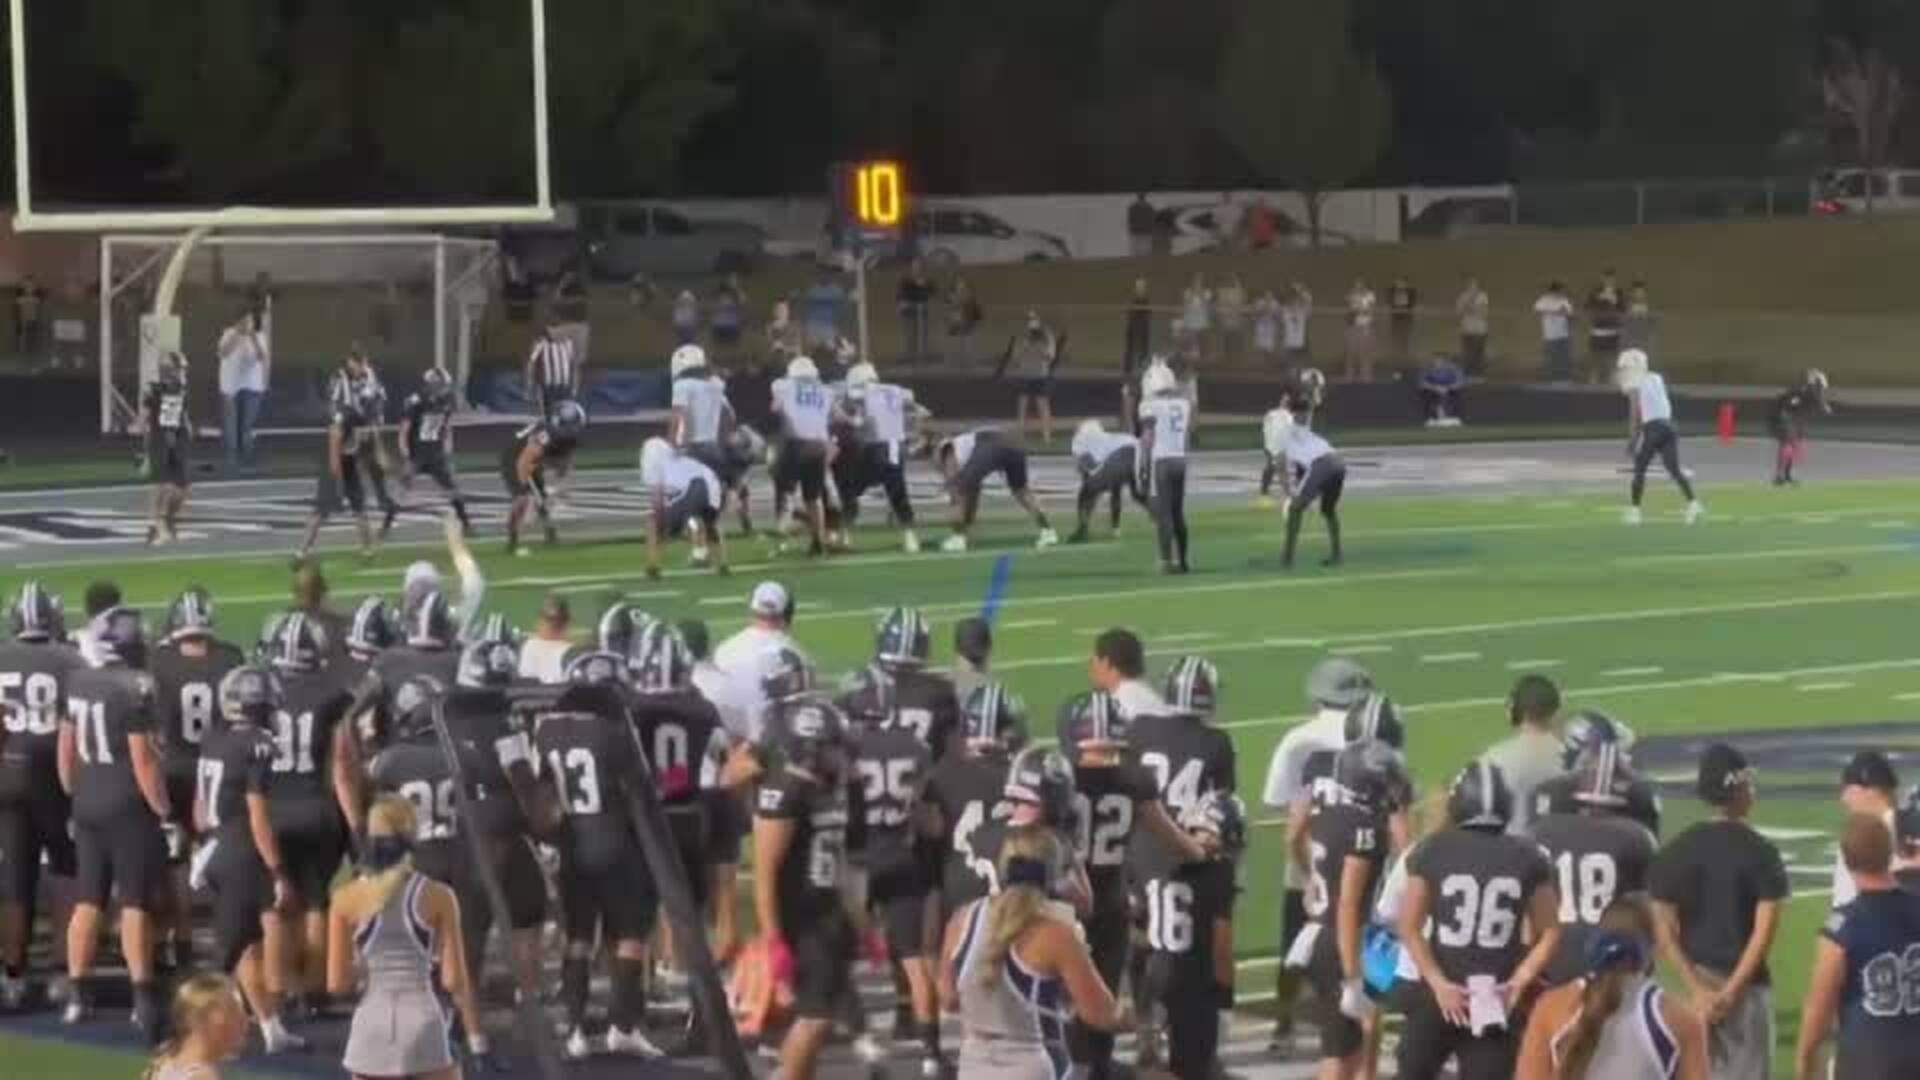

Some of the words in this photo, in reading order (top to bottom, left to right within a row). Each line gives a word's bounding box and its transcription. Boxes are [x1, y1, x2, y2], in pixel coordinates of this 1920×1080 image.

[859, 163, 899, 224] 10
[0, 672, 57, 734] 58
[68, 697, 114, 765] 71
[181, 682, 212, 743] 8
[548, 748, 601, 815] 13
[1145, 877, 1195, 952] 16
[1437, 873, 1522, 949] 36
[1556, 851, 1617, 925] 18
